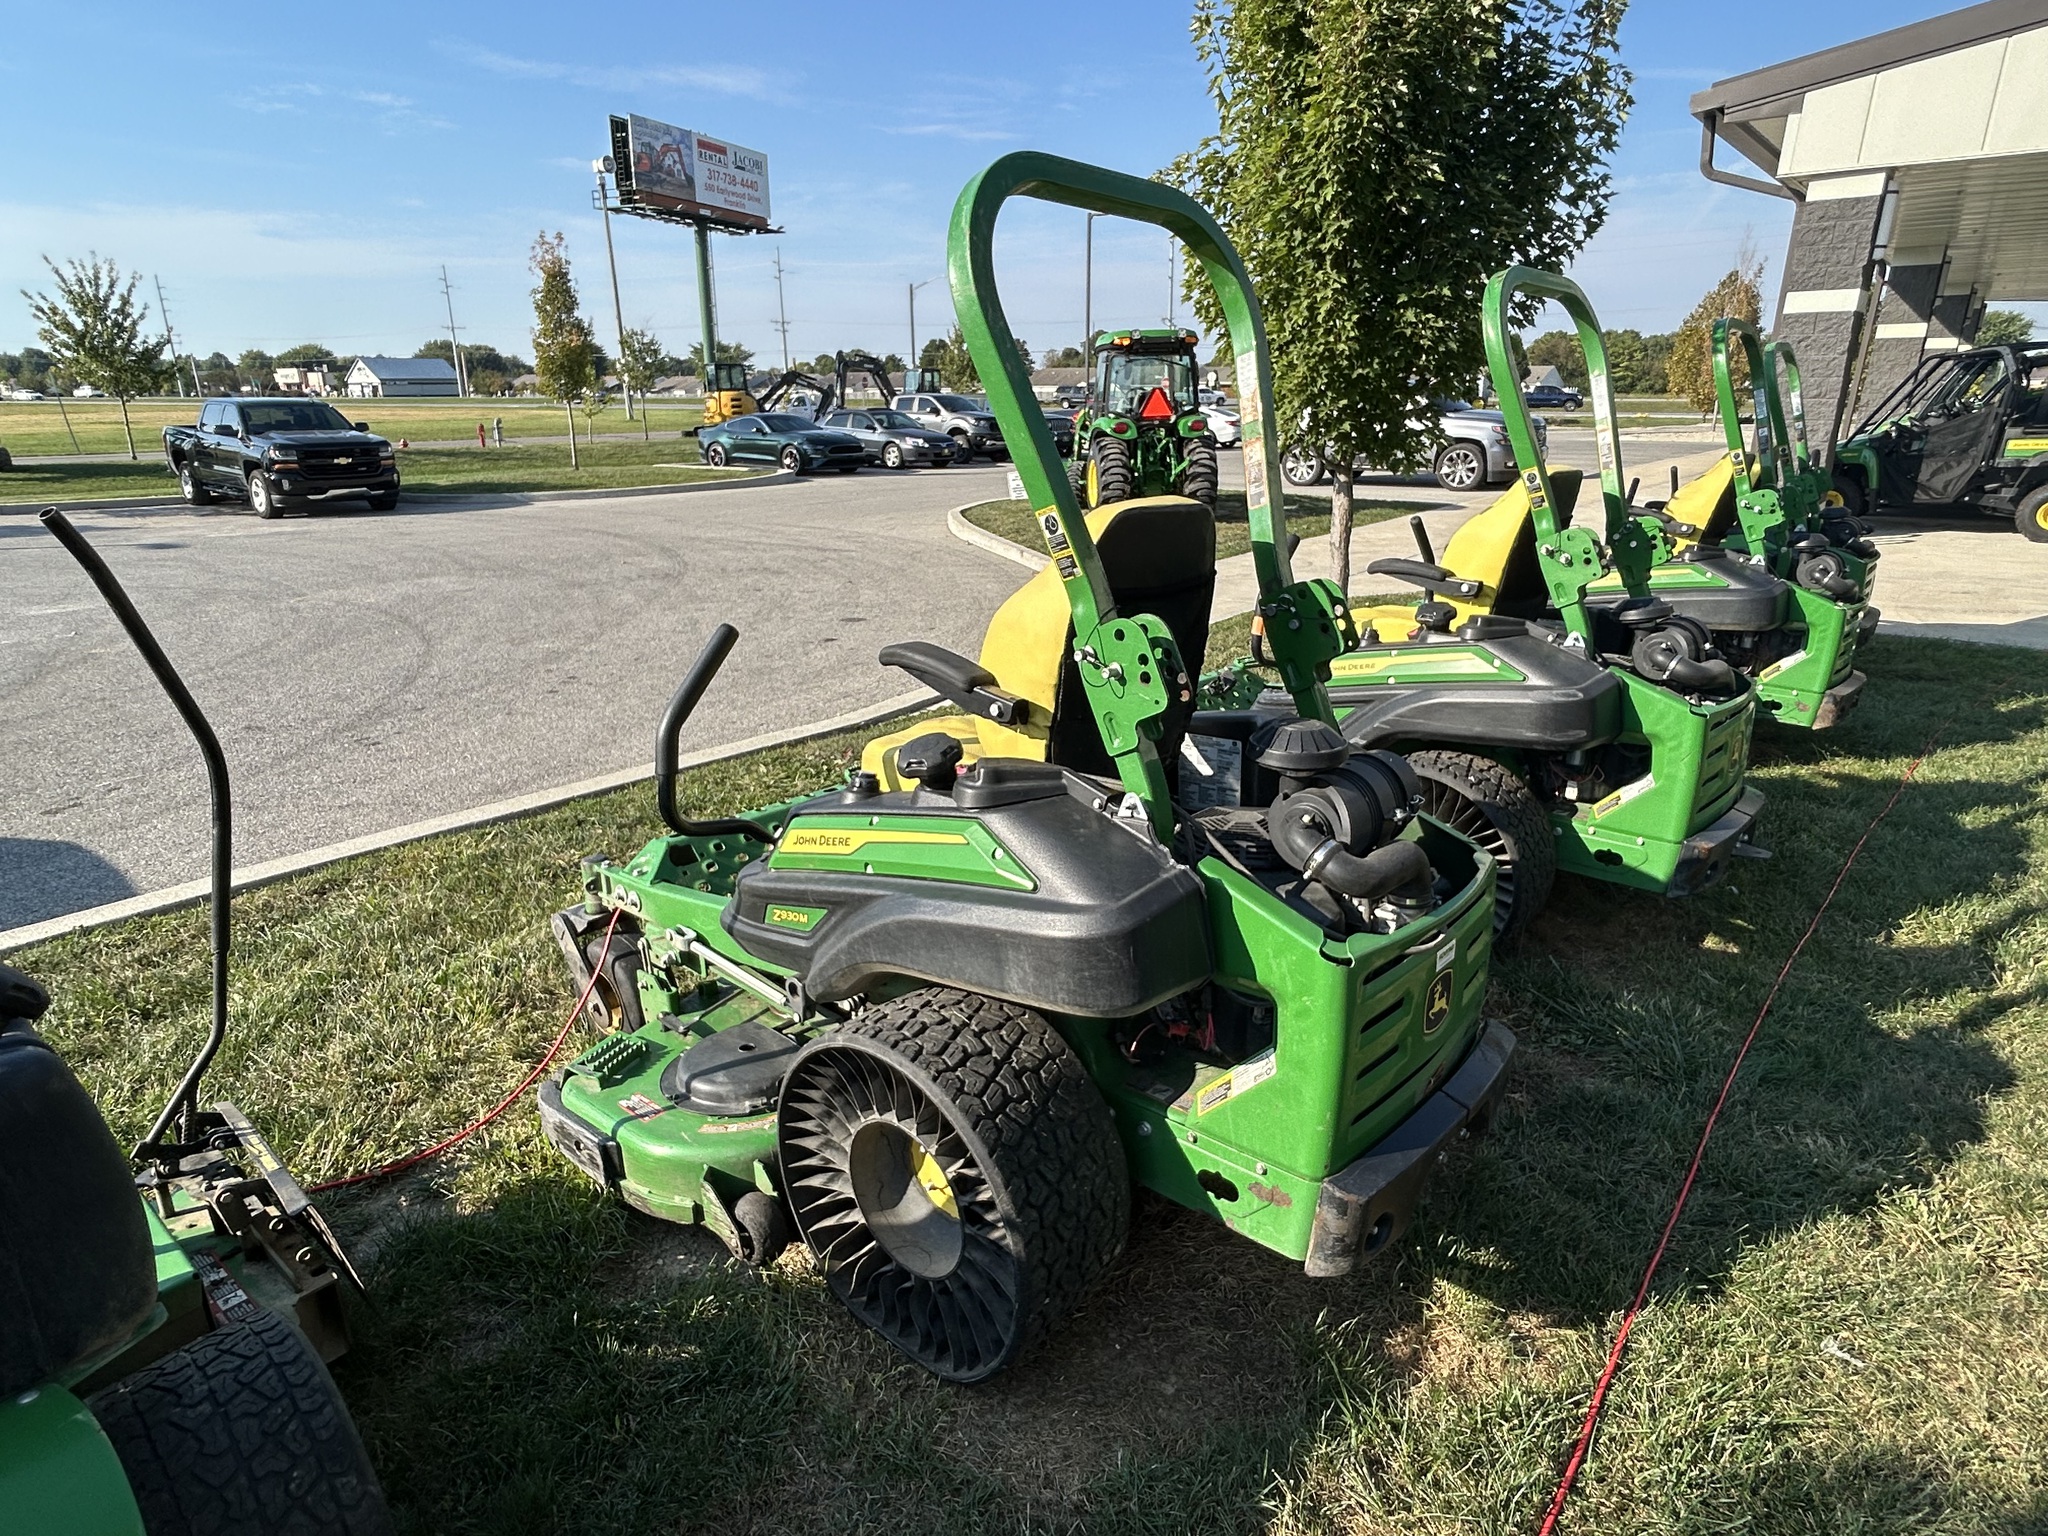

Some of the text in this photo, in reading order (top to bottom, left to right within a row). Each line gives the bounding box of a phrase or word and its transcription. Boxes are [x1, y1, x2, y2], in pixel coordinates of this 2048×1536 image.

[699, 149, 728, 166] RENTAL
[732, 151, 763, 171] JACOBI
[707, 167, 759, 192] 317-738-4440
[793, 834, 851, 847] JOHN DEERE
[772, 909, 809, 924] Z930M
